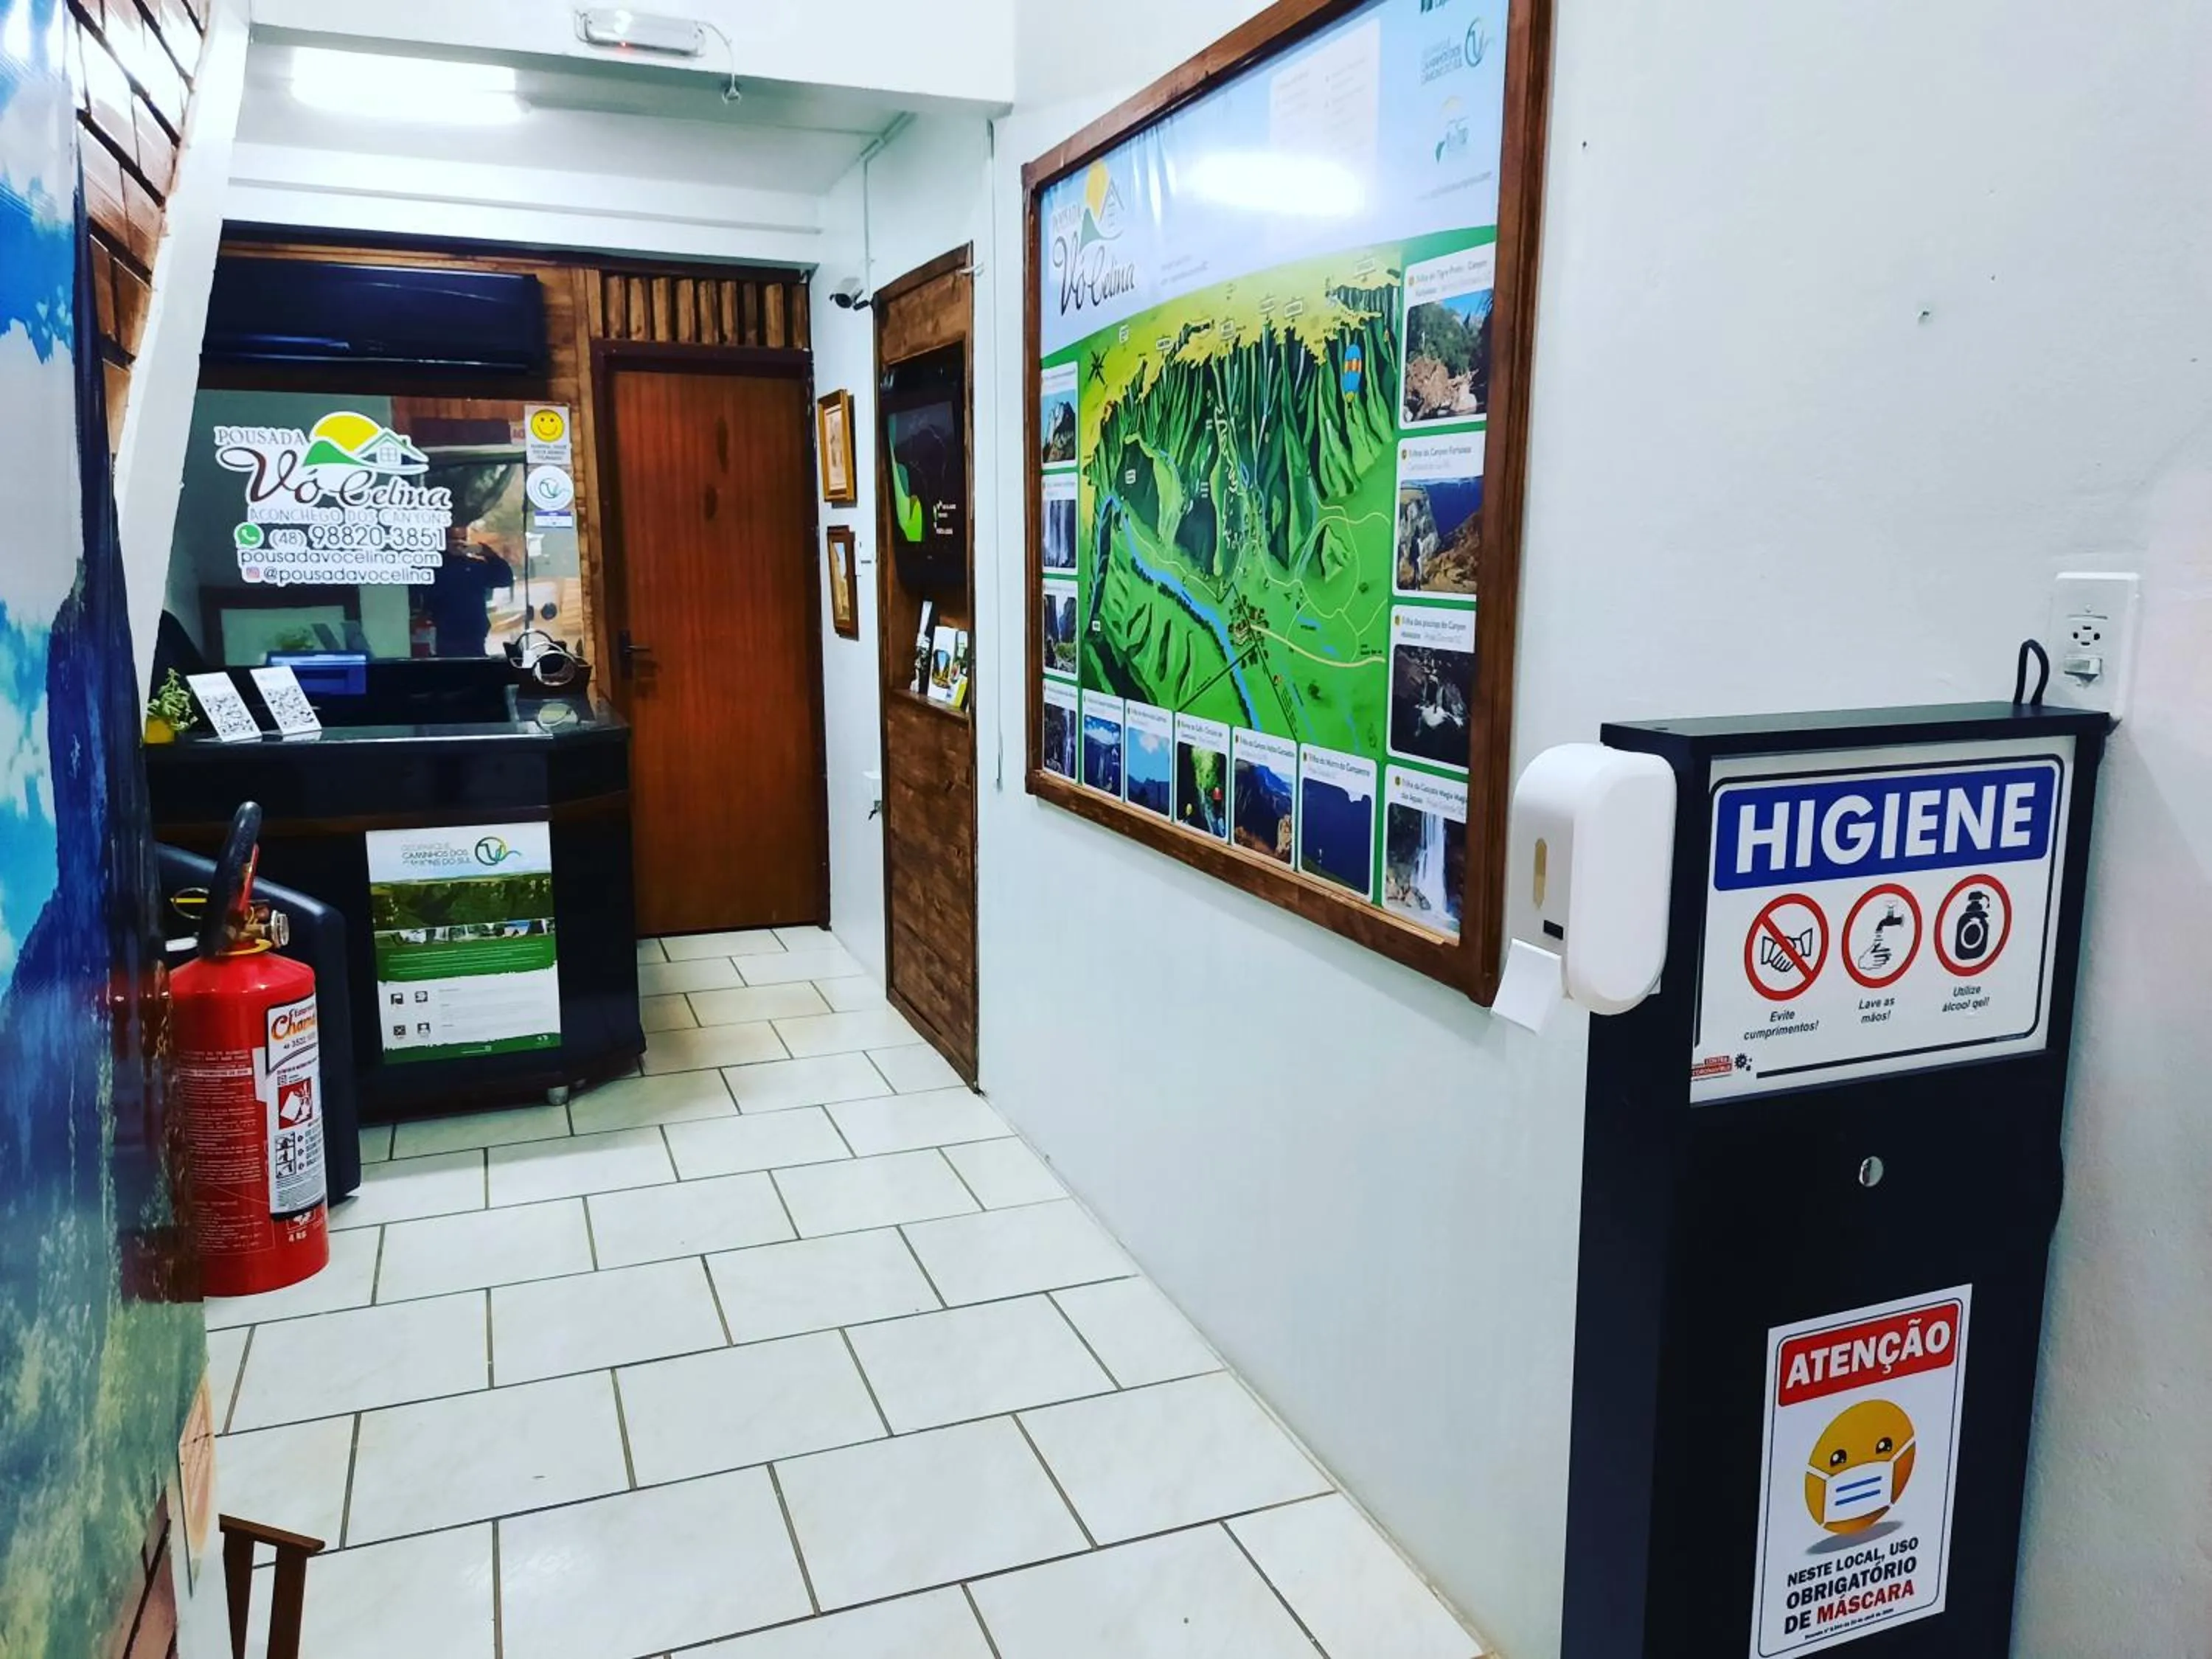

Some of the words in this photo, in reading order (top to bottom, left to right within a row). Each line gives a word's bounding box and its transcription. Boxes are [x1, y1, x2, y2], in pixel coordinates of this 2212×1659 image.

[217, 428, 305, 446] POUSADA
[220, 446, 322, 504] Vó
[329, 470, 450, 507] Celina
[251, 508, 341, 523] ACONCHEGO
[347, 509, 377, 522] DOS
[382, 510, 451, 526] CANYONS
[271, 530, 304, 546] (48)
[312, 526, 444, 549] 98820-3851
[240, 549, 441, 566] pousadavocelina.com
[263, 566, 433, 583] @pousadavocelina
[1736, 782, 2036, 874] HIGIENE
[1952, 985, 1981, 997] Utilize
[1858, 998, 1882, 1010] Lave
[1883, 997, 1896, 1006] as
[1941, 999, 1971, 1013] álcool
[1972, 996, 1990, 1009] gel!
[1770, 1009, 1795, 1023] Evite
[1861, 1009, 1891, 1023] mãos!
[1743, 1020, 1820, 1040] cumprimentos!
[1785, 1318, 1951, 1390] ATENÇÃO
[1787, 1561, 1833, 1587] NESTE
[1835, 1547, 1885, 1572] LOCAL,
[1889, 1537, 1919, 1556] USO
[1786, 1555, 1917, 1610] OBRIGATÓRIO
[1784, 1609, 1812, 1635] DE
[1816, 1579, 1915, 1624] MÁSCARA
